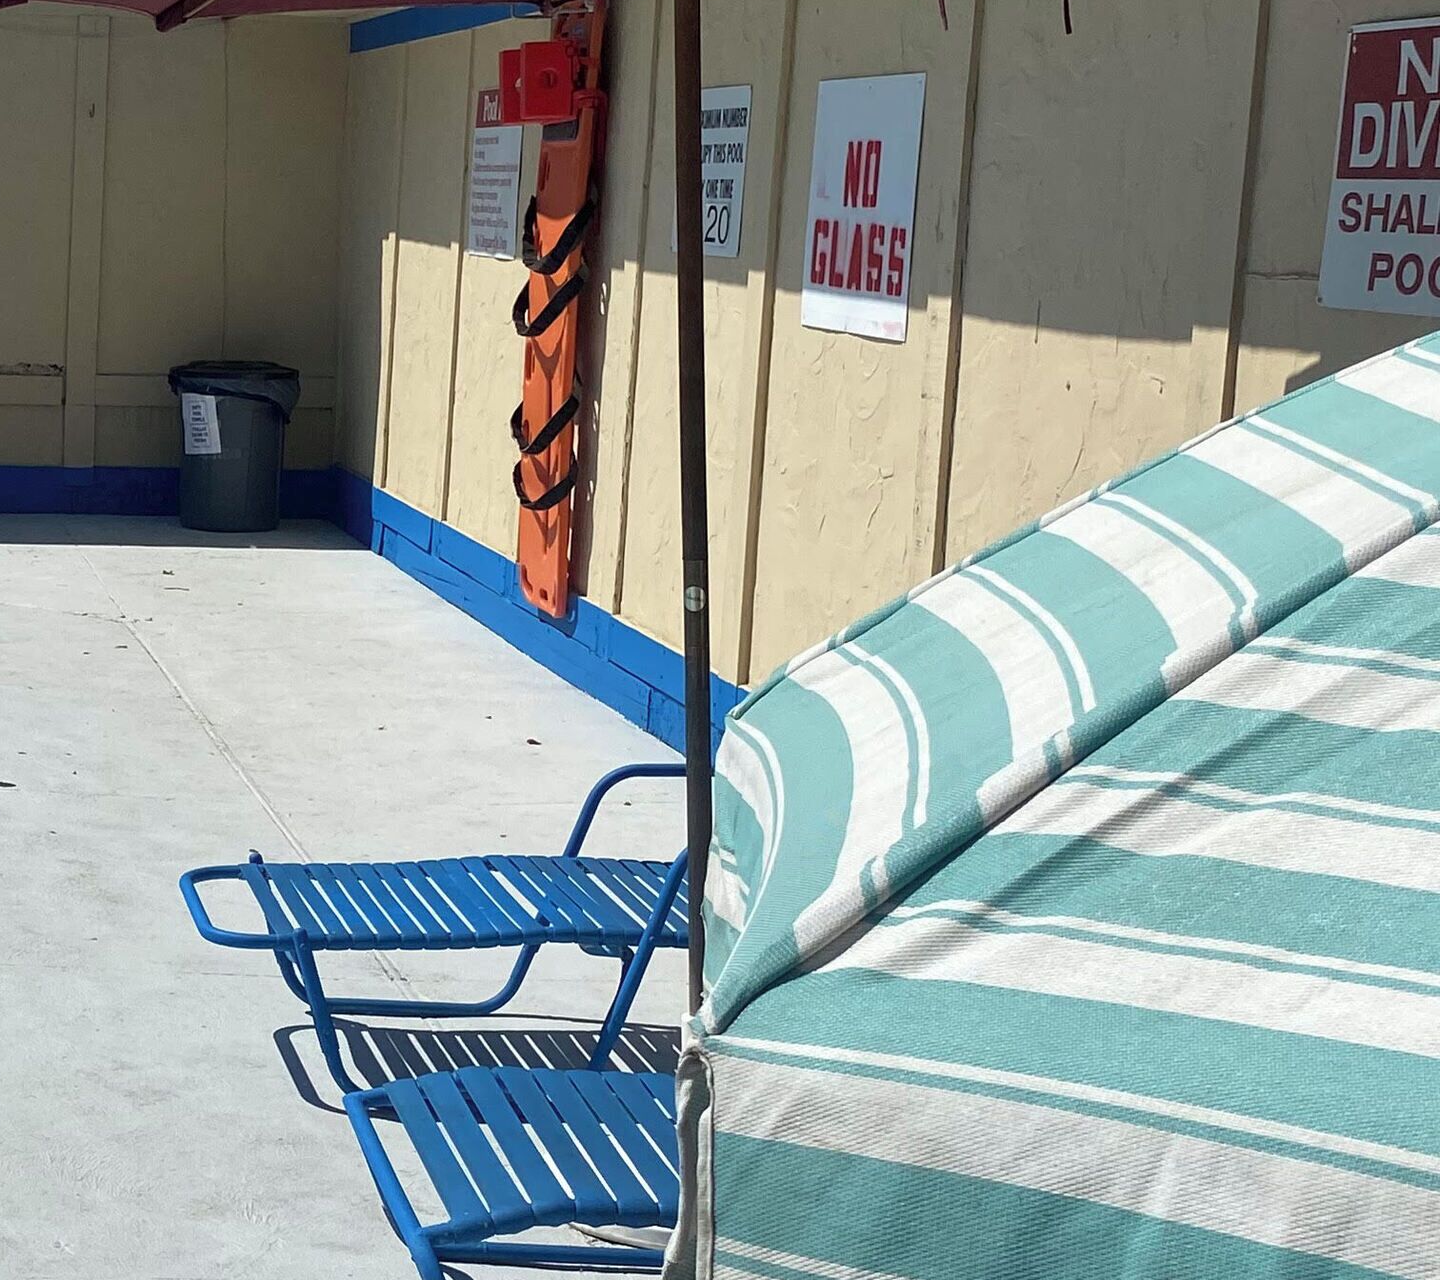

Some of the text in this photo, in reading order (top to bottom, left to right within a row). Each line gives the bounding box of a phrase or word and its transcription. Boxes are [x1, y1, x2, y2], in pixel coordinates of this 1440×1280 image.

[483, 95, 498, 122] Pool
[721, 107, 748, 128] NUMBER
[1348, 100, 1440, 169] DIV
[713, 143, 727, 163] THIS
[727, 143, 743, 163] POOL
[706, 179, 719, 199] ONE
[719, 179, 734, 199] TIME
[843, 140, 882, 208] NO
[704, 205, 730, 244] 20
[810, 218, 906, 297] GLASS
